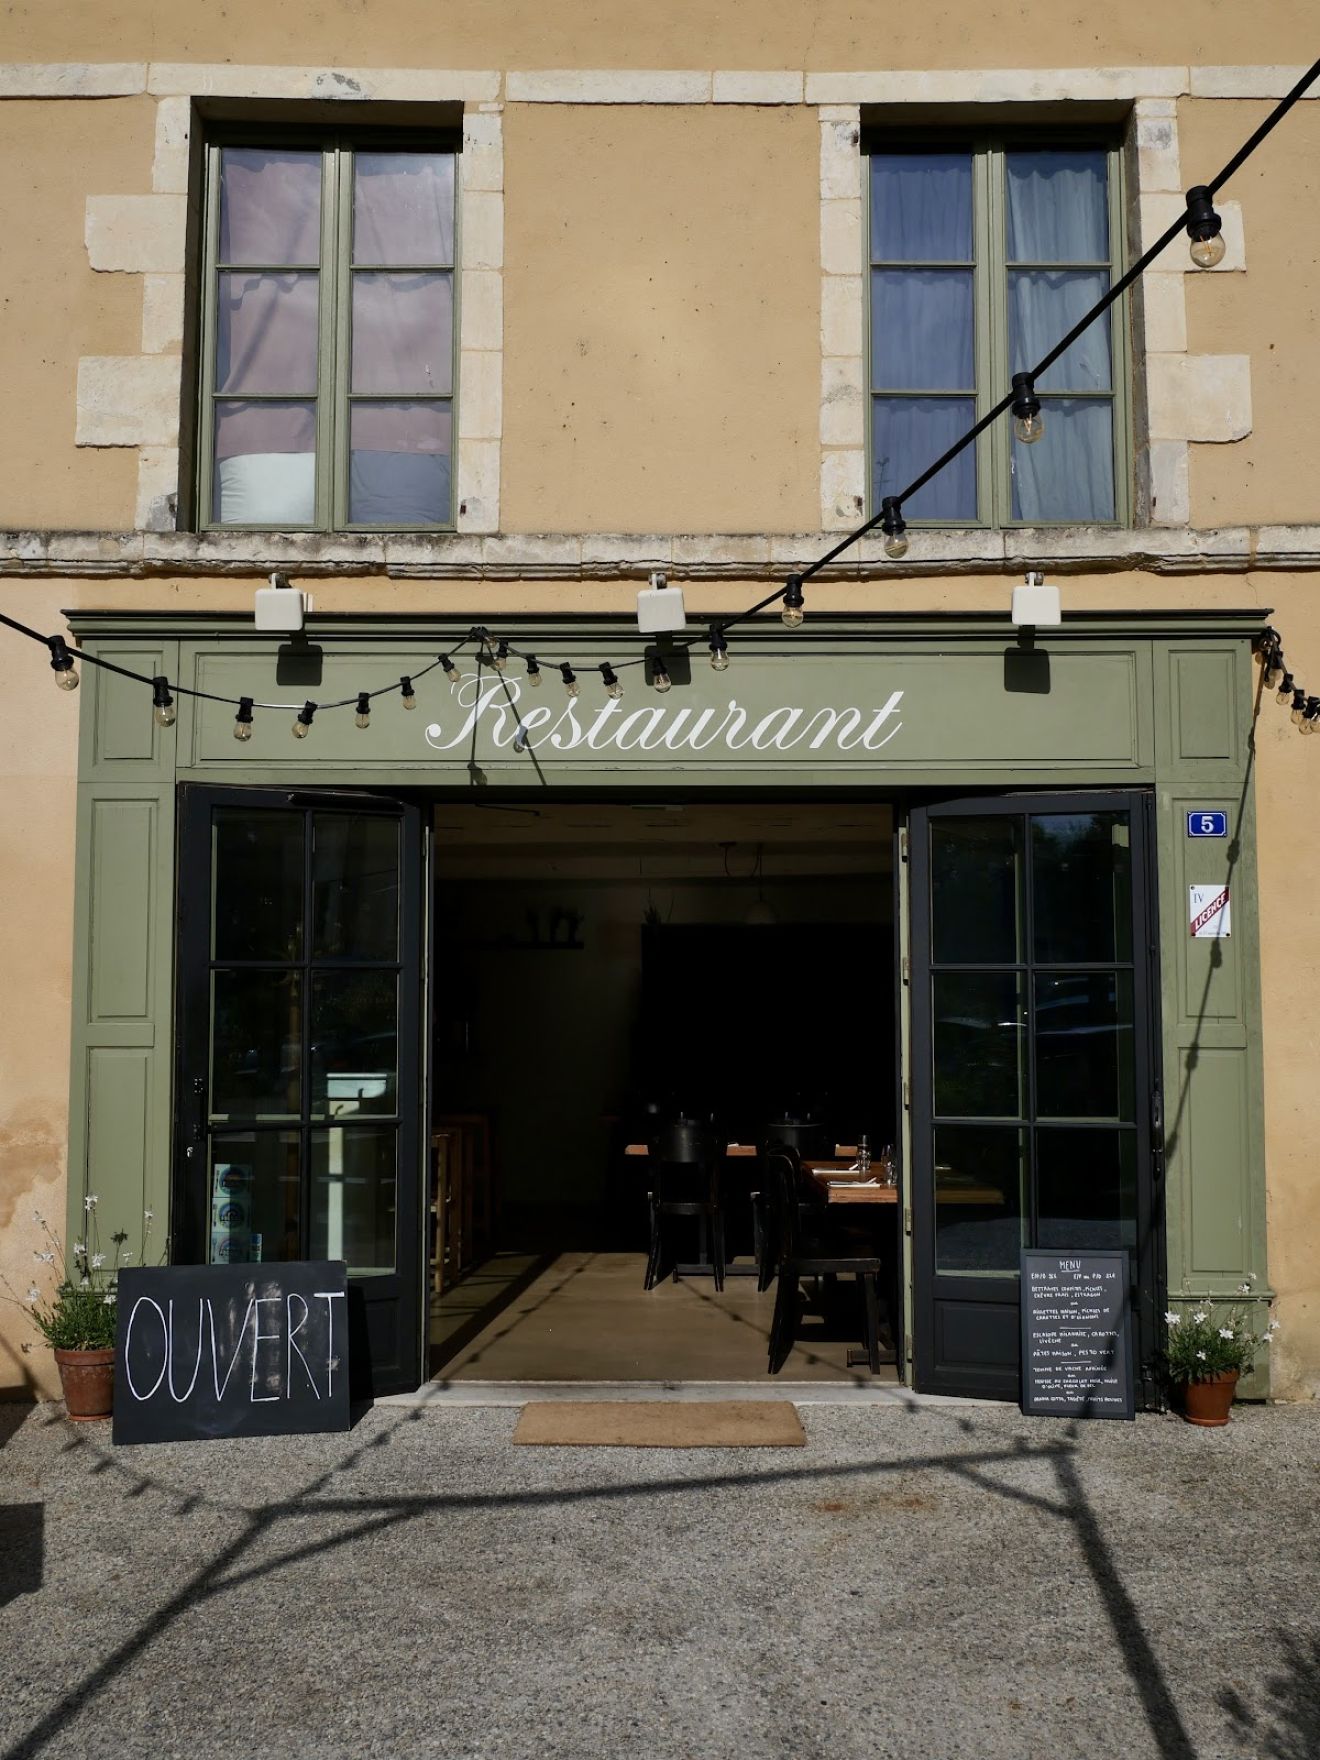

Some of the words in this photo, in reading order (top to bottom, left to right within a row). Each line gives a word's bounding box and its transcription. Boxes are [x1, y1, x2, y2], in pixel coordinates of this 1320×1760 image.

[425, 673, 905, 750] Restaurant
[1201, 816, 1214, 833] 5
[1194, 892, 1226, 930] LICENCE
[1059, 1260, 1081, 1270] MENU
[125, 1291, 345, 1403] OUVERT
